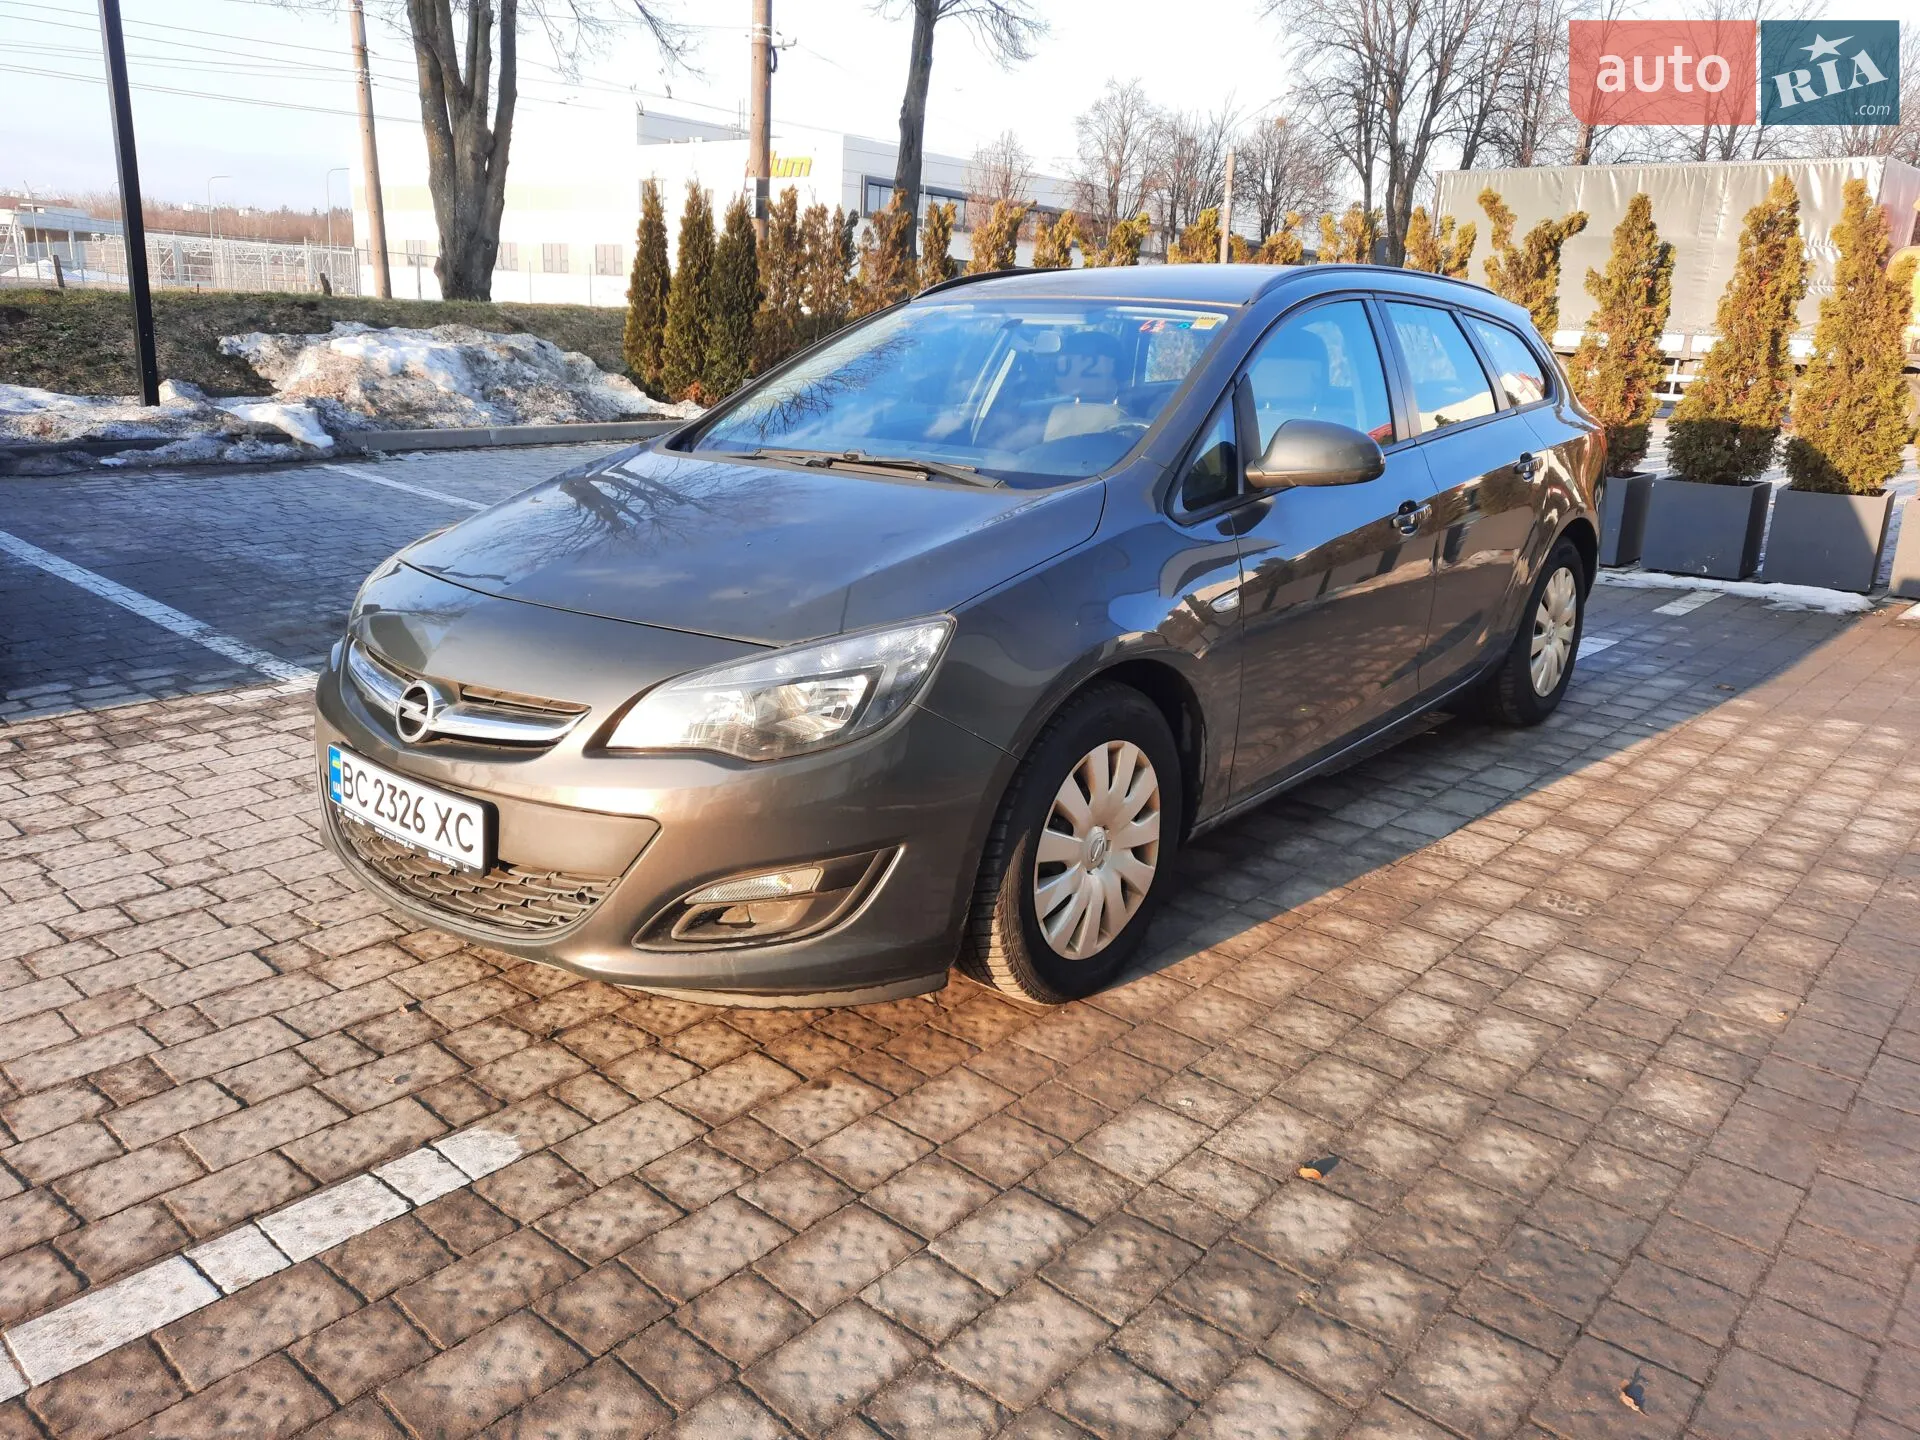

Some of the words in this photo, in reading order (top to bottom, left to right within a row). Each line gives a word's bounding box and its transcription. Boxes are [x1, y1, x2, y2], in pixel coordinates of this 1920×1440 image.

[342, 761, 369, 808] BC
[373, 778, 426, 834] 2326
[434, 802, 474, 853] XC
